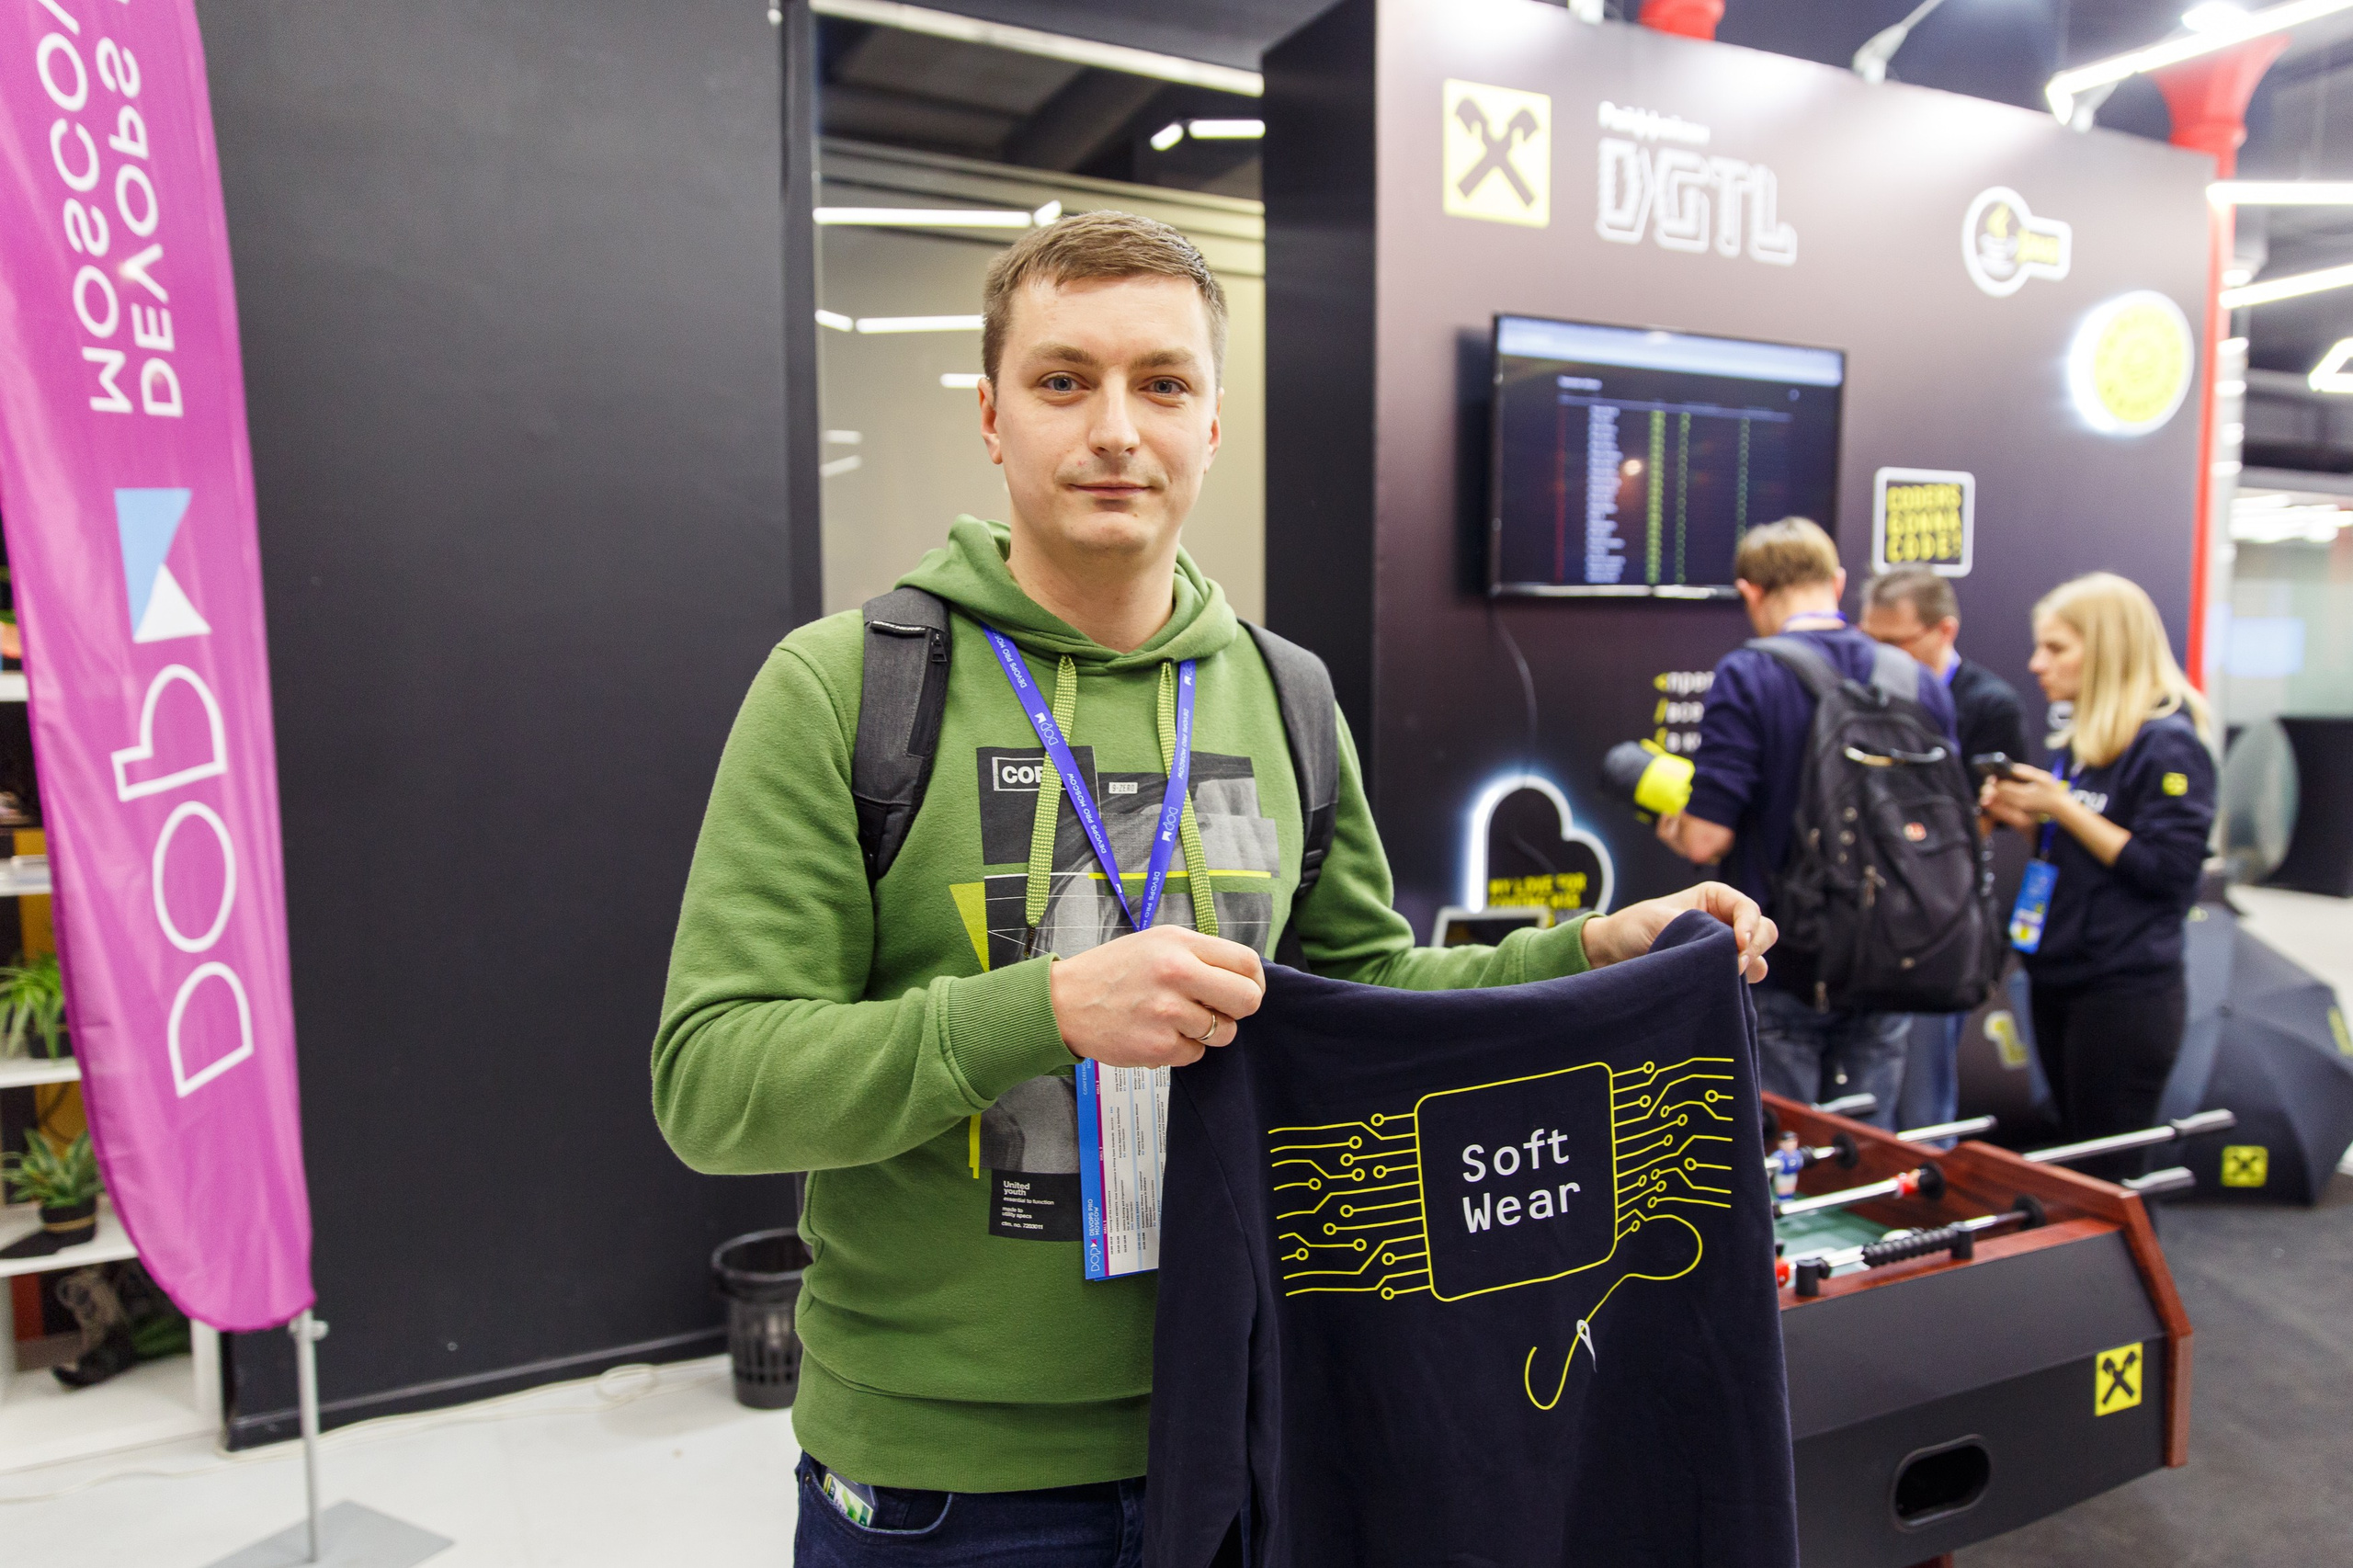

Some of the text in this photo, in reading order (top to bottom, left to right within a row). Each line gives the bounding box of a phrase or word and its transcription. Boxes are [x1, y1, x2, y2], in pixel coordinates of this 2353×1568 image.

[1596, 137, 1798, 267] DGTL
[1002, 648, 1014, 663] PRO
[1009, 662, 1028, 688] DEVOPS
[1066, 773, 1108, 854] DEVOPS PRO MOSCOW
[1148, 870, 1161, 901] DEVOPS
[1144, 903, 1153, 918] PRO
[1461, 1128, 1570, 1183] Soft
[1003, 1180, 1030, 1190] United
[1003, 1187, 1027, 1196] youth
[1462, 1181, 1581, 1233] Wear
